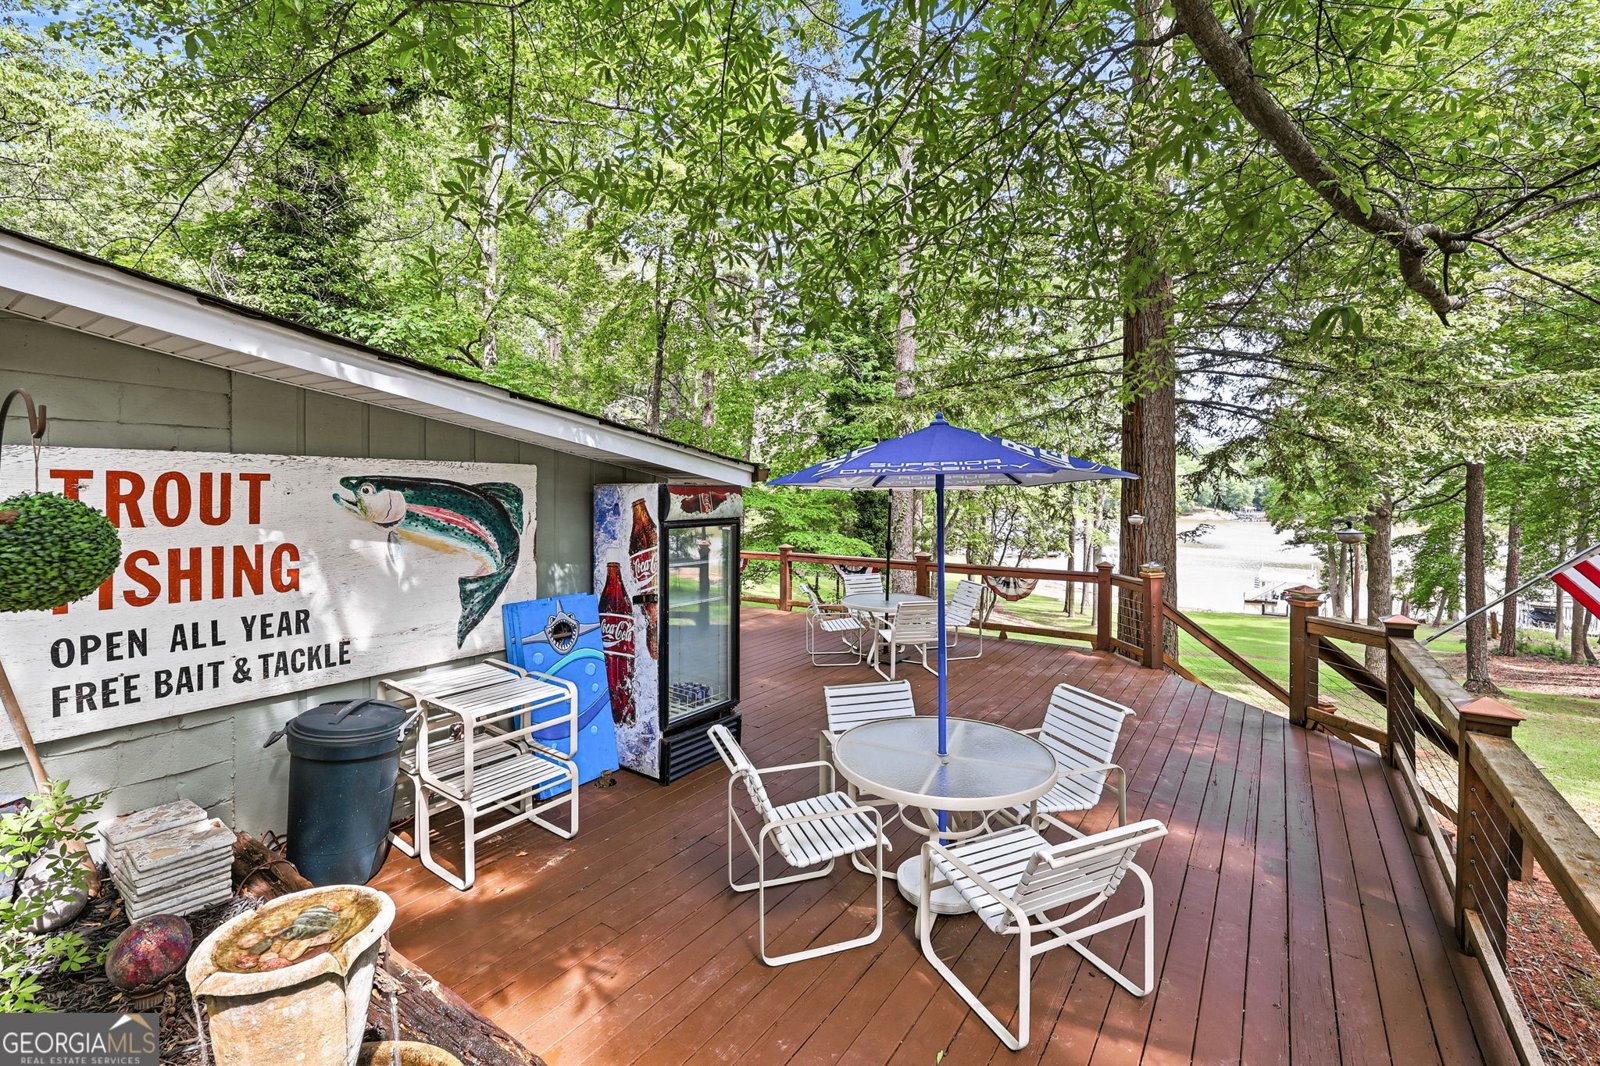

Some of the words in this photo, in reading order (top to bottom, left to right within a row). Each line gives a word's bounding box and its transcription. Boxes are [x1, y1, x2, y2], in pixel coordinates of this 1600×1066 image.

[839, 462, 1031, 474] DRINKABILITY
[870, 458, 1001, 468] SUPERIOR
[50, 469, 271, 528] TROUT
[52, 543, 300, 616] ISHING
[50, 627, 148, 669] OPEN
[170, 620, 227, 654] ALL
[240, 608, 311, 643] YEAR
[601, 618, 634, 642] Coca-Cola
[51, 673, 141, 718] FREE
[154, 661, 226, 700] BAIT
[232, 657, 252, 684] &
[258, 640, 352, 680] TACKLE
